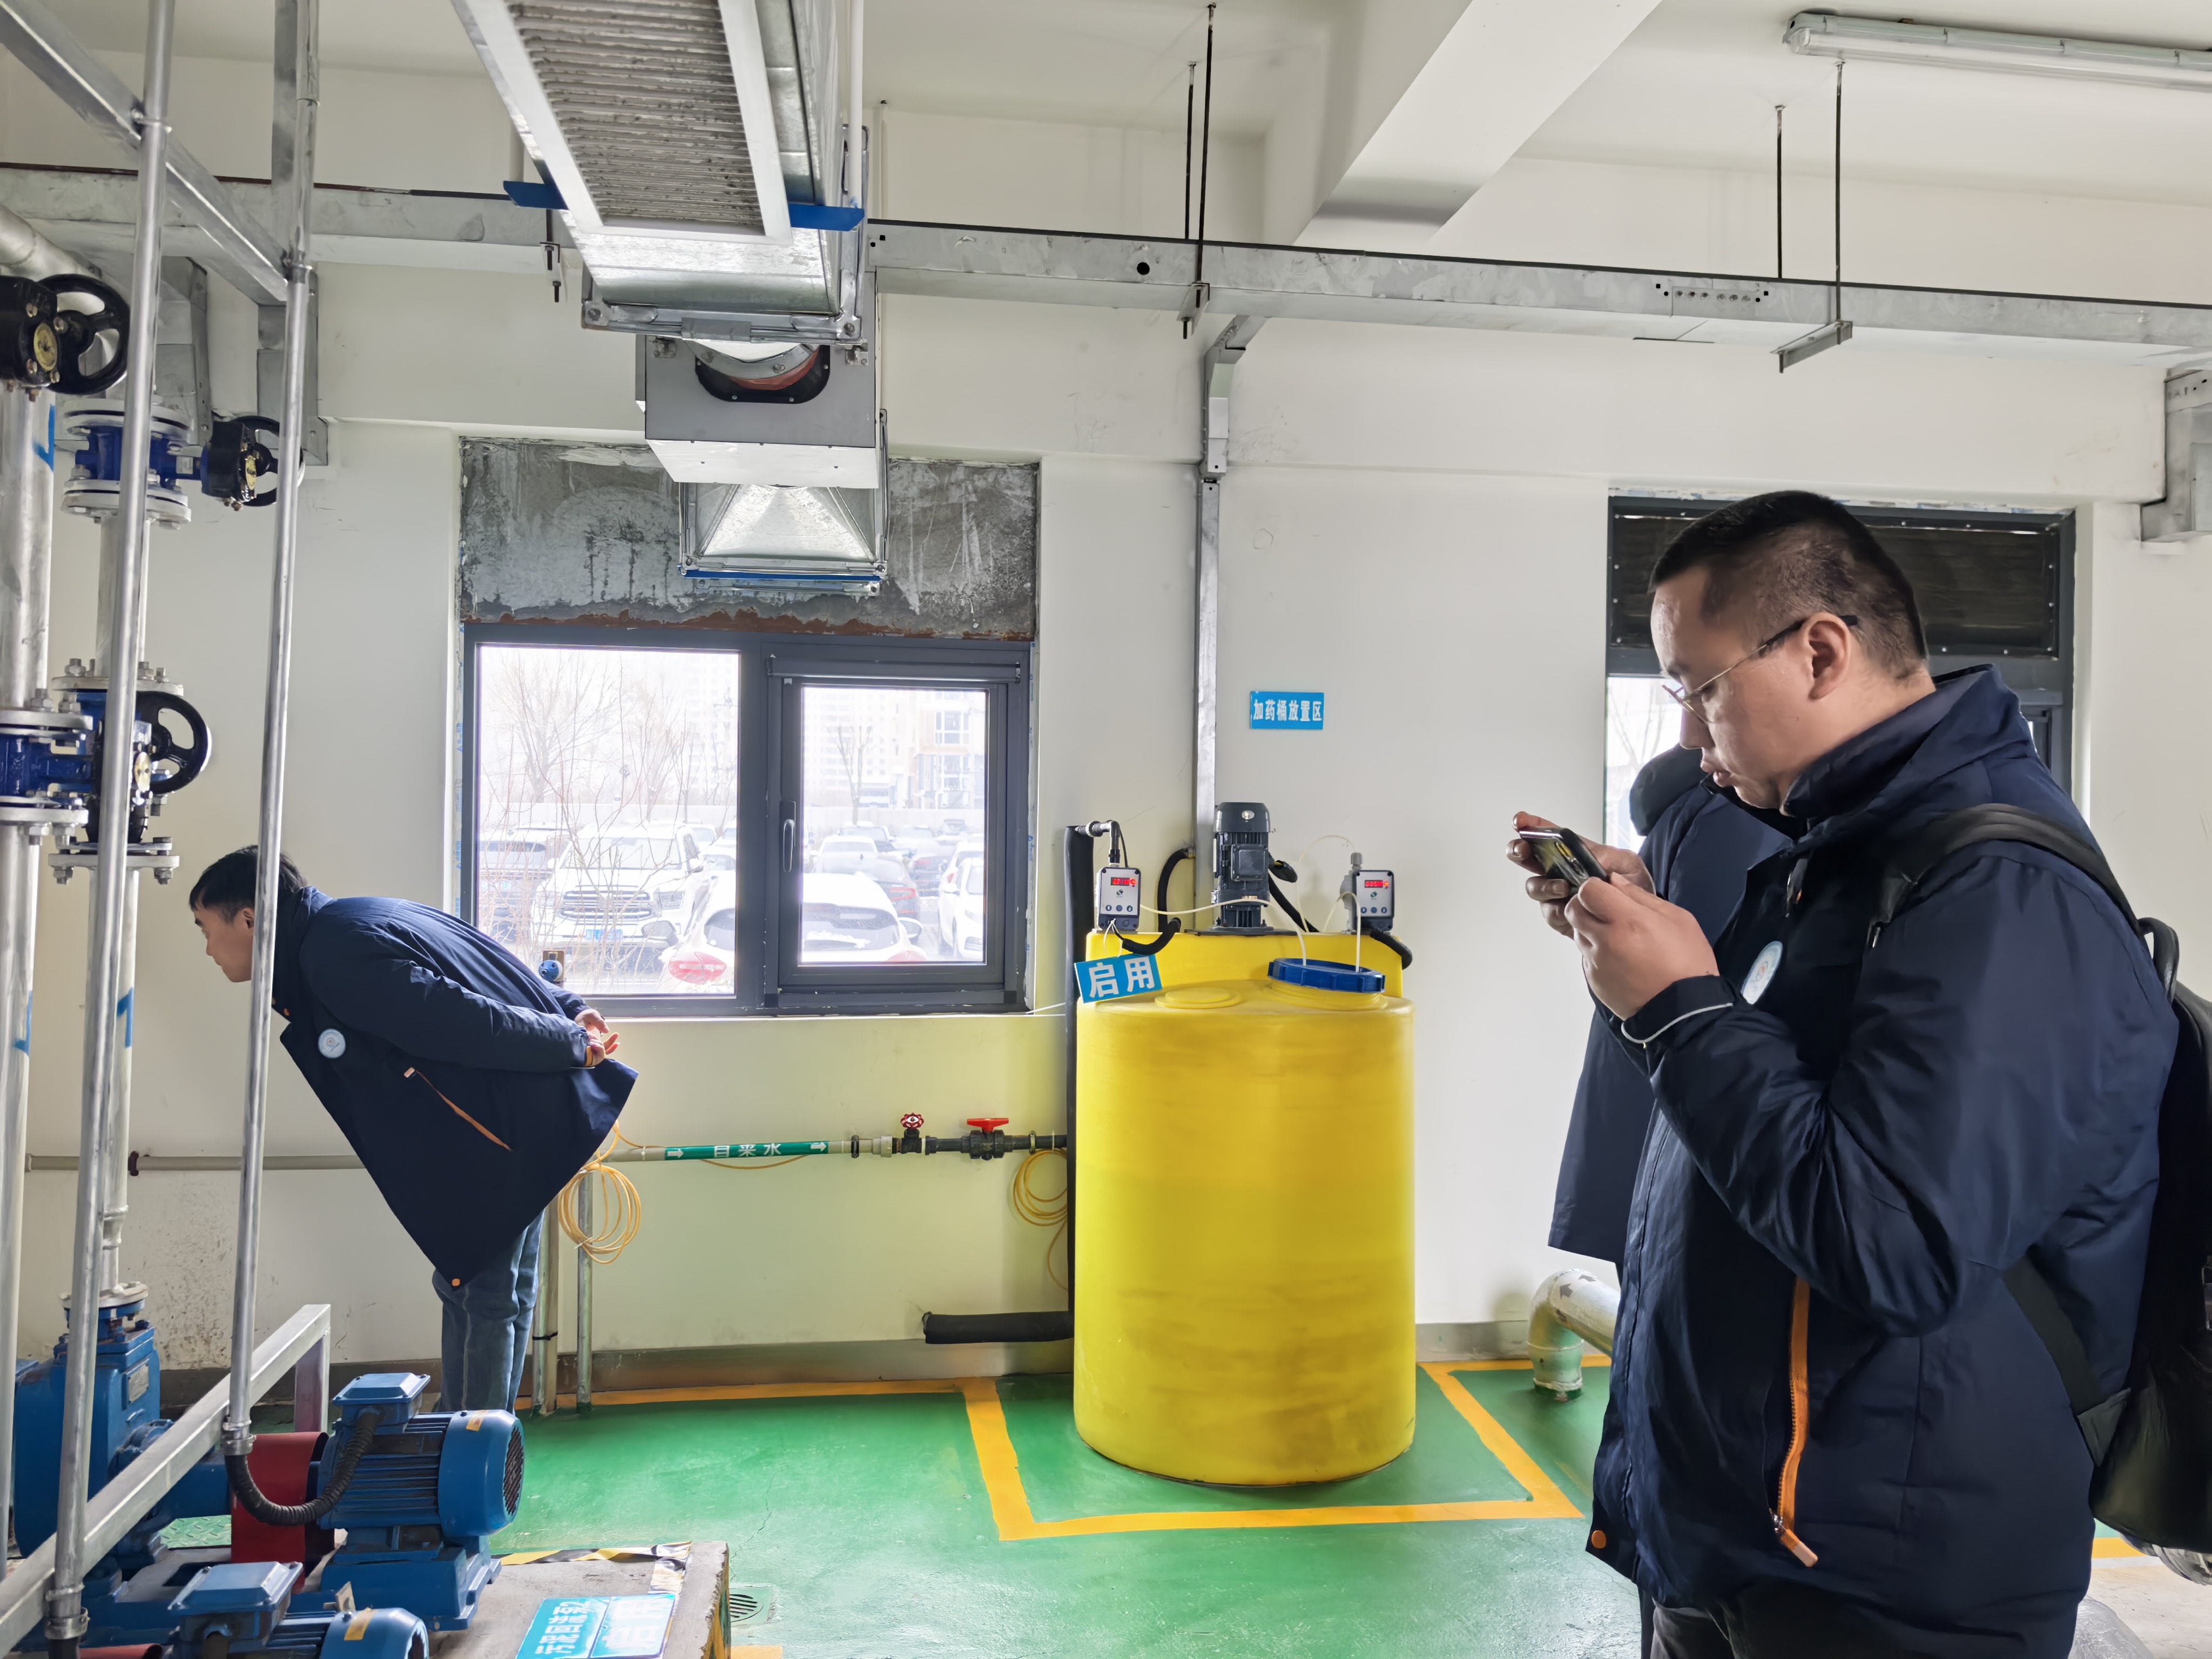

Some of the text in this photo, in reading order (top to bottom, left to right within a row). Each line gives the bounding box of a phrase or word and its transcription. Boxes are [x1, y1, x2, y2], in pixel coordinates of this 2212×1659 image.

[1253, 699, 1322, 721] 加药桶放置区
[1090, 957, 1155, 999] 启用
